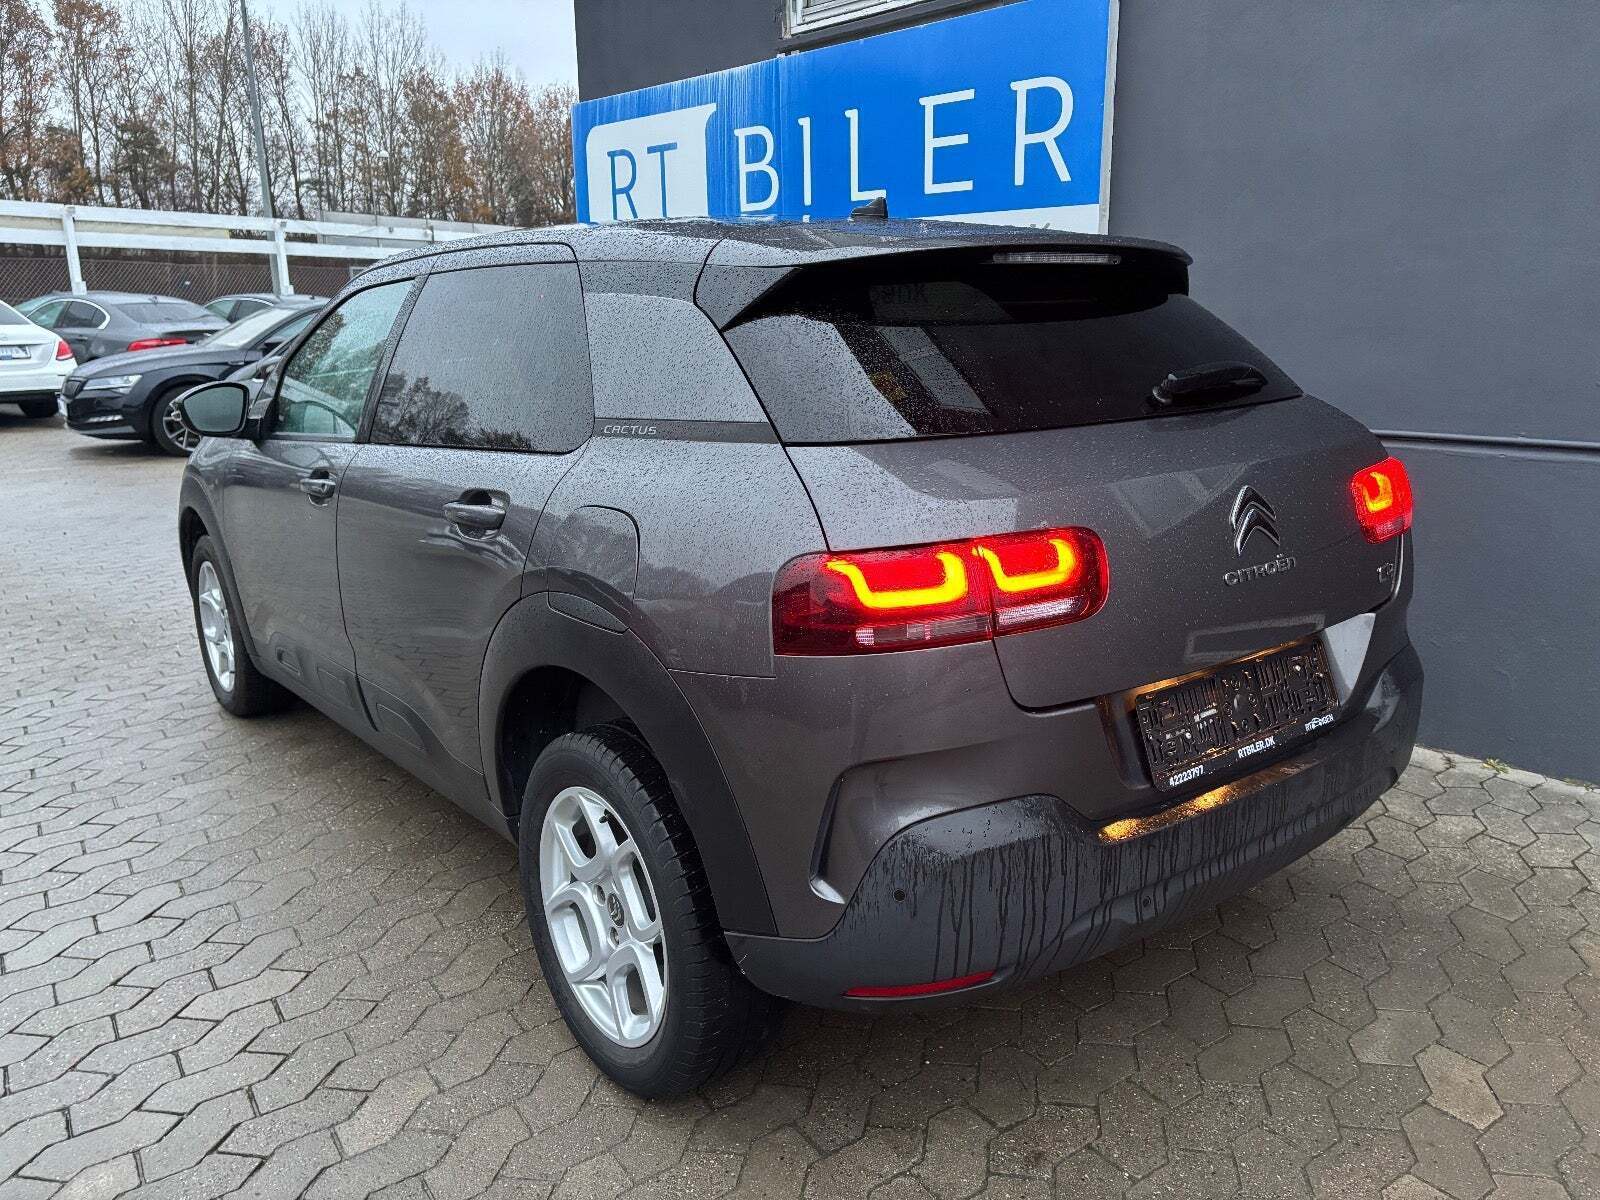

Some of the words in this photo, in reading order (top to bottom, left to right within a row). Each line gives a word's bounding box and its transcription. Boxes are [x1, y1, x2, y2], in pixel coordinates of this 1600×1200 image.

[606, 142, 678, 220] RT
[734, 75, 1074, 213] BILER
[603, 425, 657, 435] CACTUS
[1237, 735, 1276, 759] RTBILER.DK
[1169, 765, 1204, 787] 42223797
